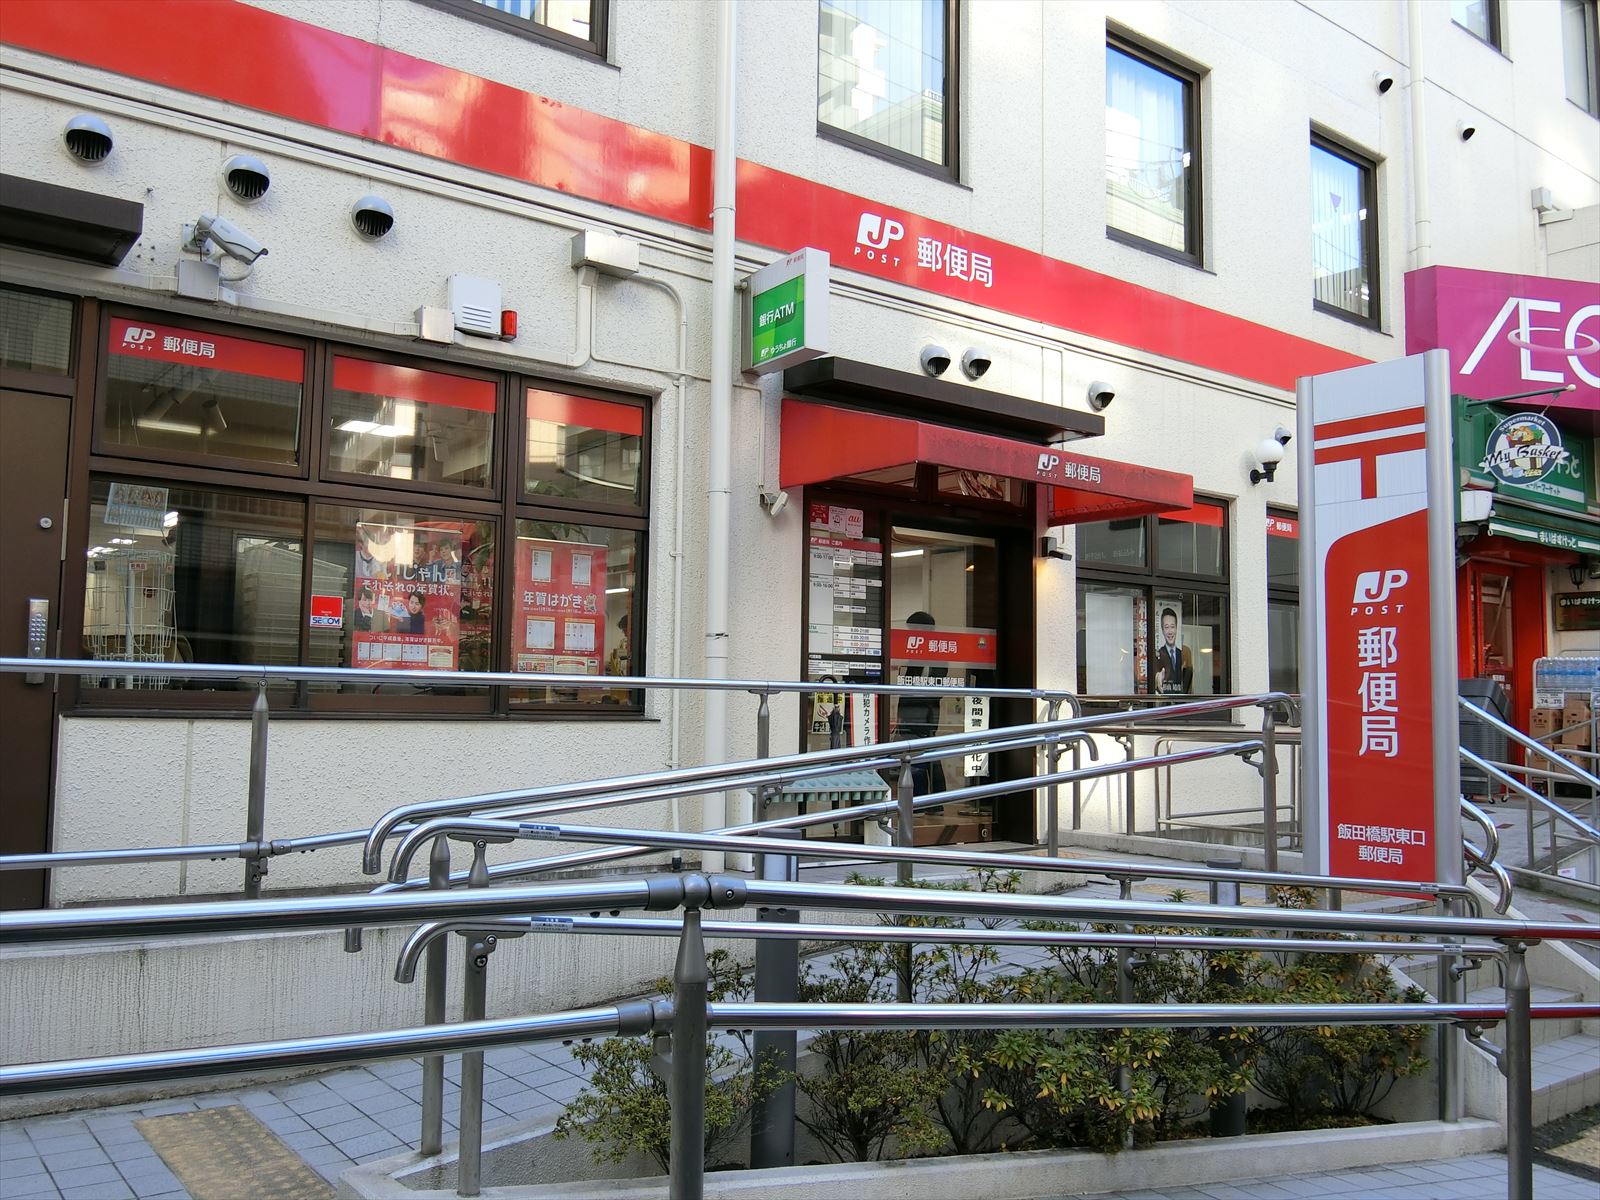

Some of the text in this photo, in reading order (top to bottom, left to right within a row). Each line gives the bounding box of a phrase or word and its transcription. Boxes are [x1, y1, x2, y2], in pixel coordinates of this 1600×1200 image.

[854, 246, 900, 267] POST
[916, 236, 993, 288] 郵便局
[759, 301, 795, 328] 銀行ATM
[124, 327, 156, 344] JP
[122, 342, 153, 352] POST
[163, 336, 216, 359] 郵便局
[770, 338, 797, 355] ゆうちょ銀行
[1499, 415, 1546, 431] Supermarket
[1038, 453, 1059, 471] JP
[1484, 445, 1562, 466] My Basket
[1064, 461, 1101, 484] 郵便局
[1276, 521, 1293, 533] 郵便局
[1538, 530, 1577, 548] まいばすけっと
[523, 590, 583, 609] 年賀はがき
[1350, 604, 1405, 616] POST
[312, 617, 340, 625] SECOM
[907, 636, 924, 649] JP
[928, 639, 958, 654] 郵便局
[1357, 626, 1398, 758] 郵便局
[1337, 822, 1426, 847] 飯田橋駅東口
[1358, 844, 1404, 865] 郵便局
